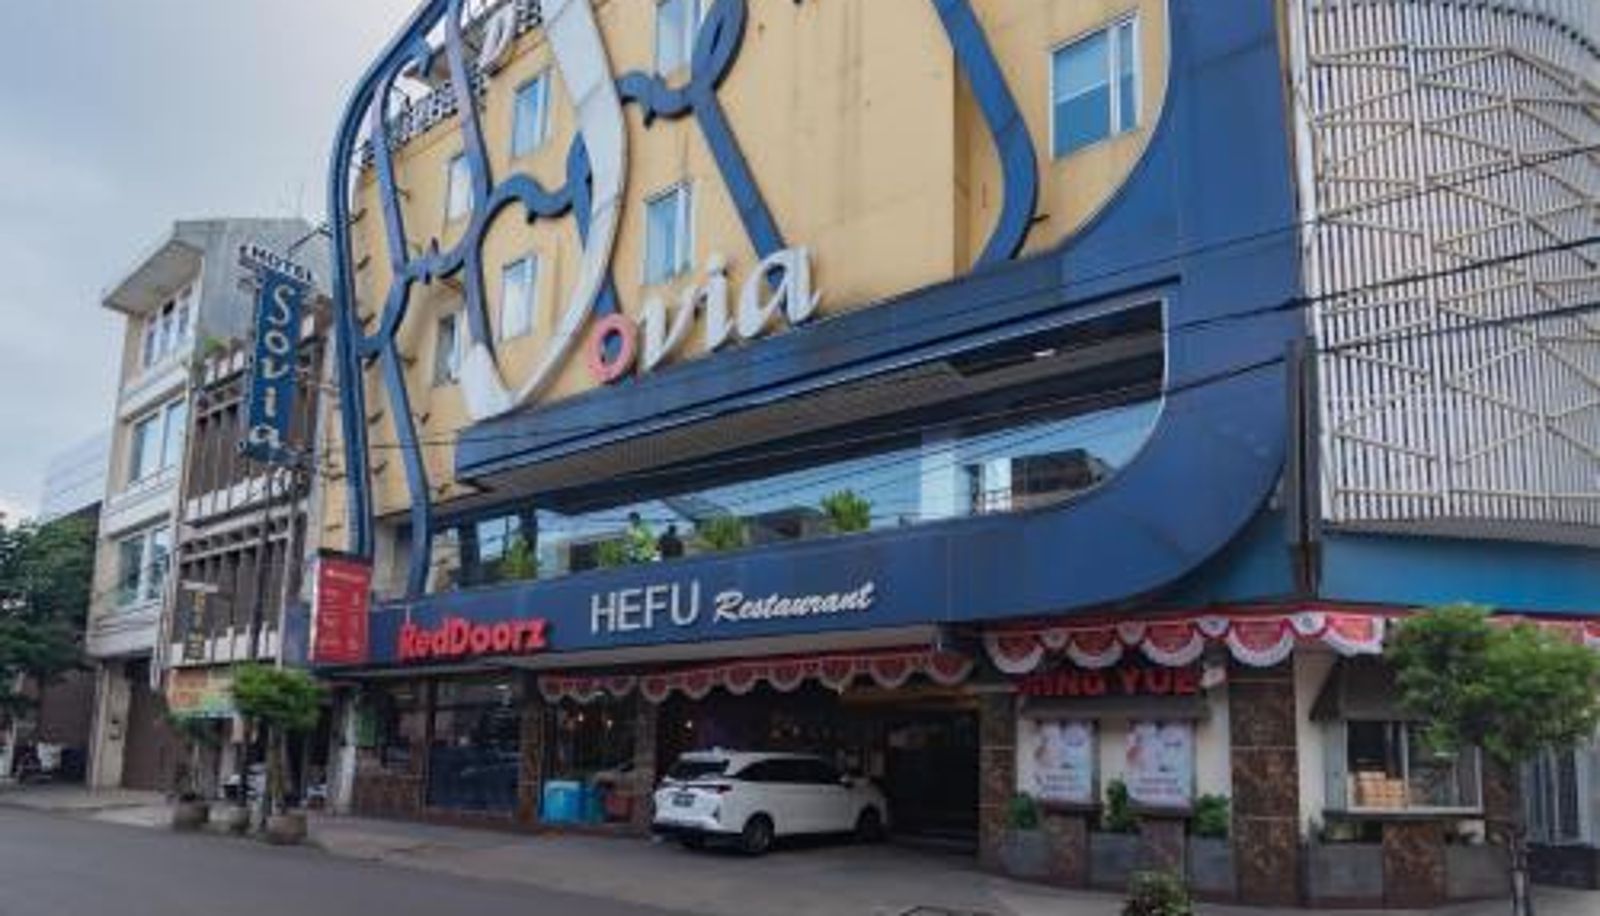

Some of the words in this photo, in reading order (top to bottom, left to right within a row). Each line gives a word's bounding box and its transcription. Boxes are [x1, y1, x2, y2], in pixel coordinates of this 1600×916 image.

[590, 579, 700, 634] HEFU
[712, 580, 875, 624] Restaurant
[396, 615, 549, 663] RedDoorz
